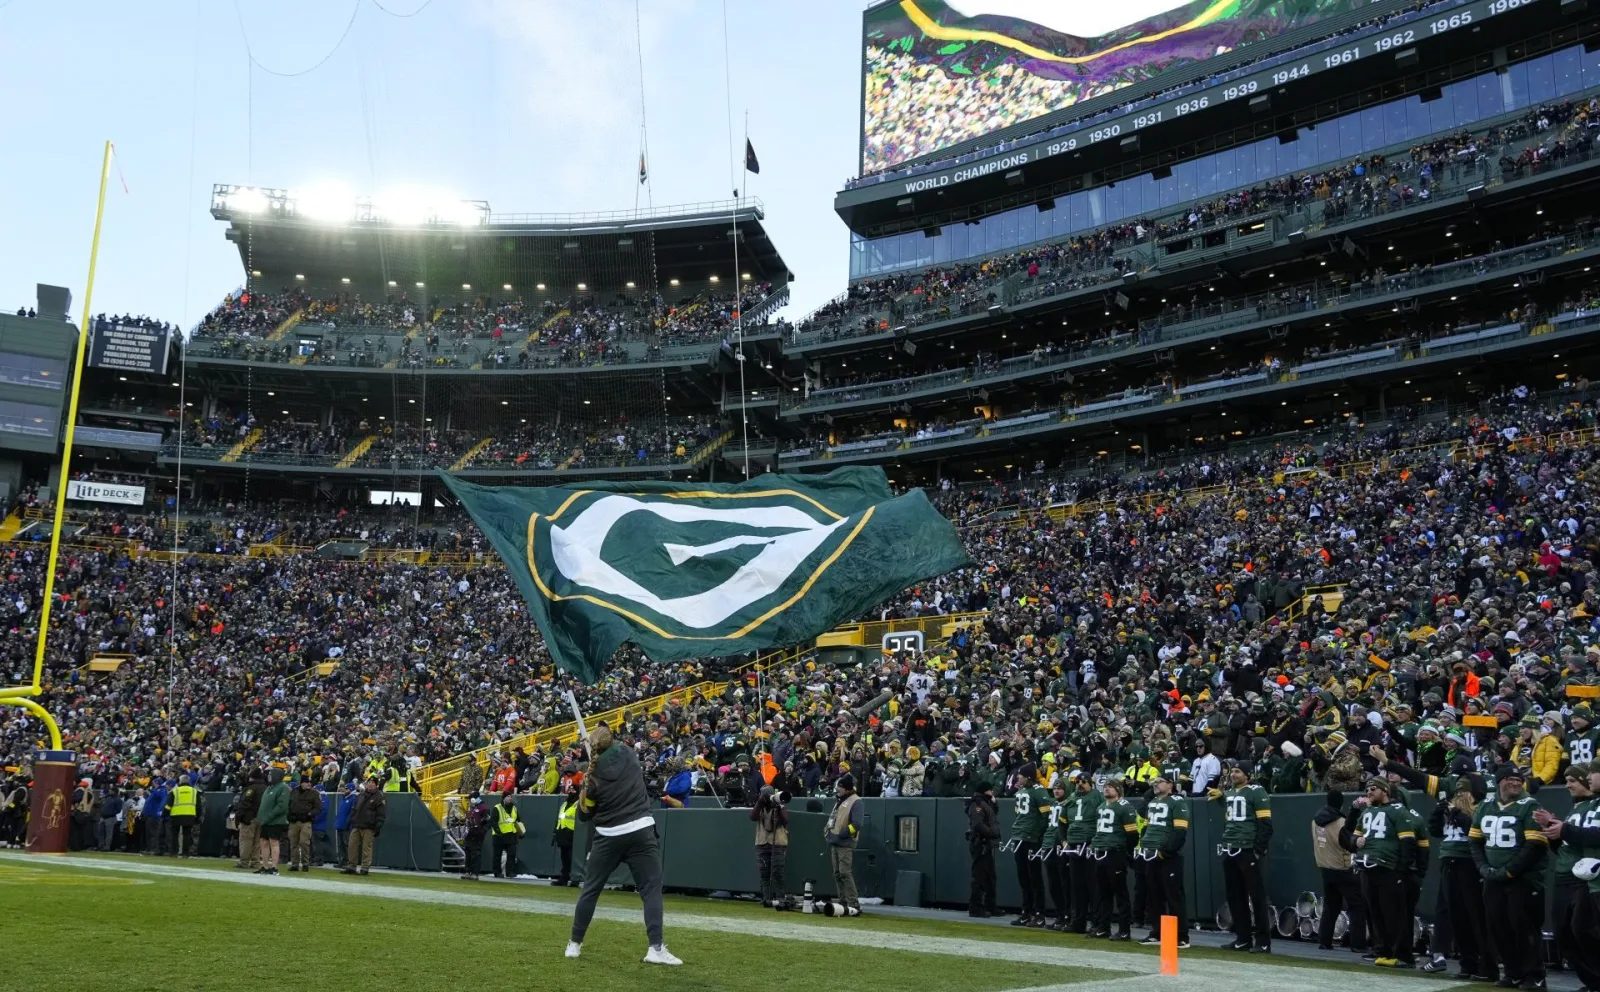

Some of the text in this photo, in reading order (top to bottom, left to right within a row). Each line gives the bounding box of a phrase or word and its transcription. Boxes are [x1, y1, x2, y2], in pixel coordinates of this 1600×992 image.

[905, 175, 949, 193] WORLD
[953, 153, 1028, 184] CHAMPIONS
[1046, 138, 1077, 156] 1929
[1088, 125, 1120, 143] 1930
[1132, 111, 1162, 129] 1931
[1175, 98, 1209, 116] 1936
[1222, 81, 1258, 101] 1939
[1272, 64, 1310, 85] 1944
[1324, 47, 1360, 69] 1961
[1374, 30, 1415, 52] 1962
[1429, 10, 1473, 35] 1965
[75, 485, 130, 498] Lite DECK
[916, 679, 928, 690] 34
[1570, 738, 1593, 765] 28
[1362, 811, 1387, 839] 94
[1480, 815, 1517, 848] 96
